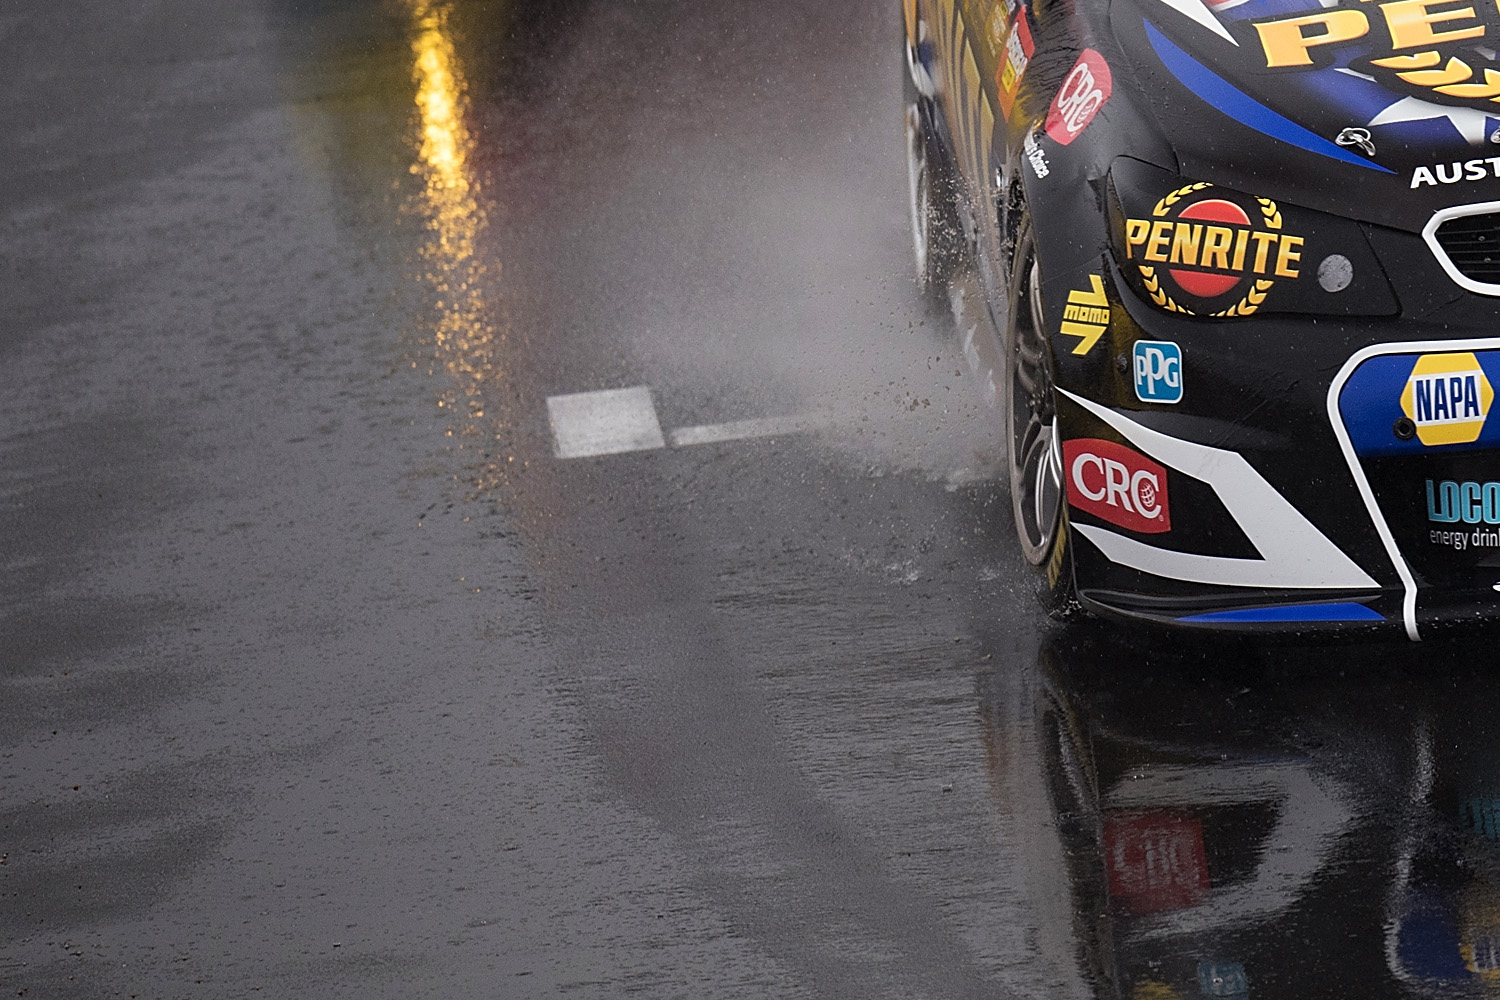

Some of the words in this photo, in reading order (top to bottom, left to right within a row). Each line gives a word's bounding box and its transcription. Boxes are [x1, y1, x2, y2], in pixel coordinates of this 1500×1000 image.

[1057, 62, 1103, 134] CRC
[1126, 218, 1304, 279] PENRITE
[1063, 305, 1110, 325] momo
[1135, 347, 1181, 395] PPG
[1415, 375, 1480, 422] NAPA
[1070, 451, 1163, 520] CRC
[1430, 530, 1469, 551] energy
